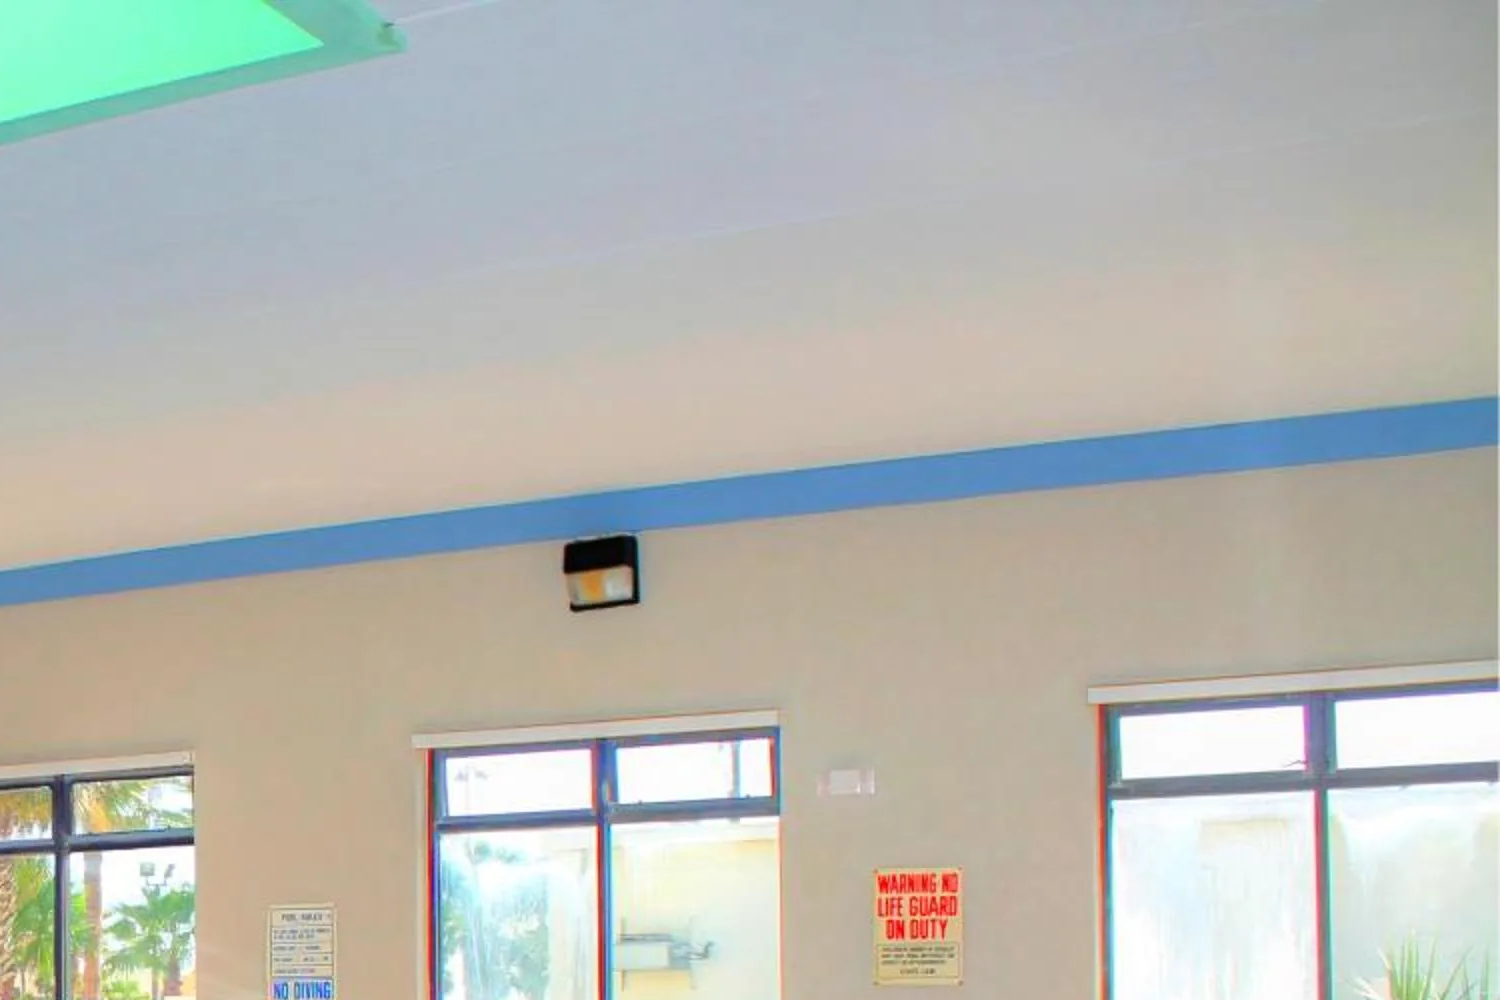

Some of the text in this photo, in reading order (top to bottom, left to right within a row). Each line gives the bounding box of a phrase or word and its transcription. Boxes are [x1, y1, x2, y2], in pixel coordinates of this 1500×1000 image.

[877, 872, 958, 893] WARNING NO
[877, 896, 958, 917] LIFE GUARD
[886, 918, 948, 940] ON DUTY
[273, 982, 331, 1000] NO DIVING
